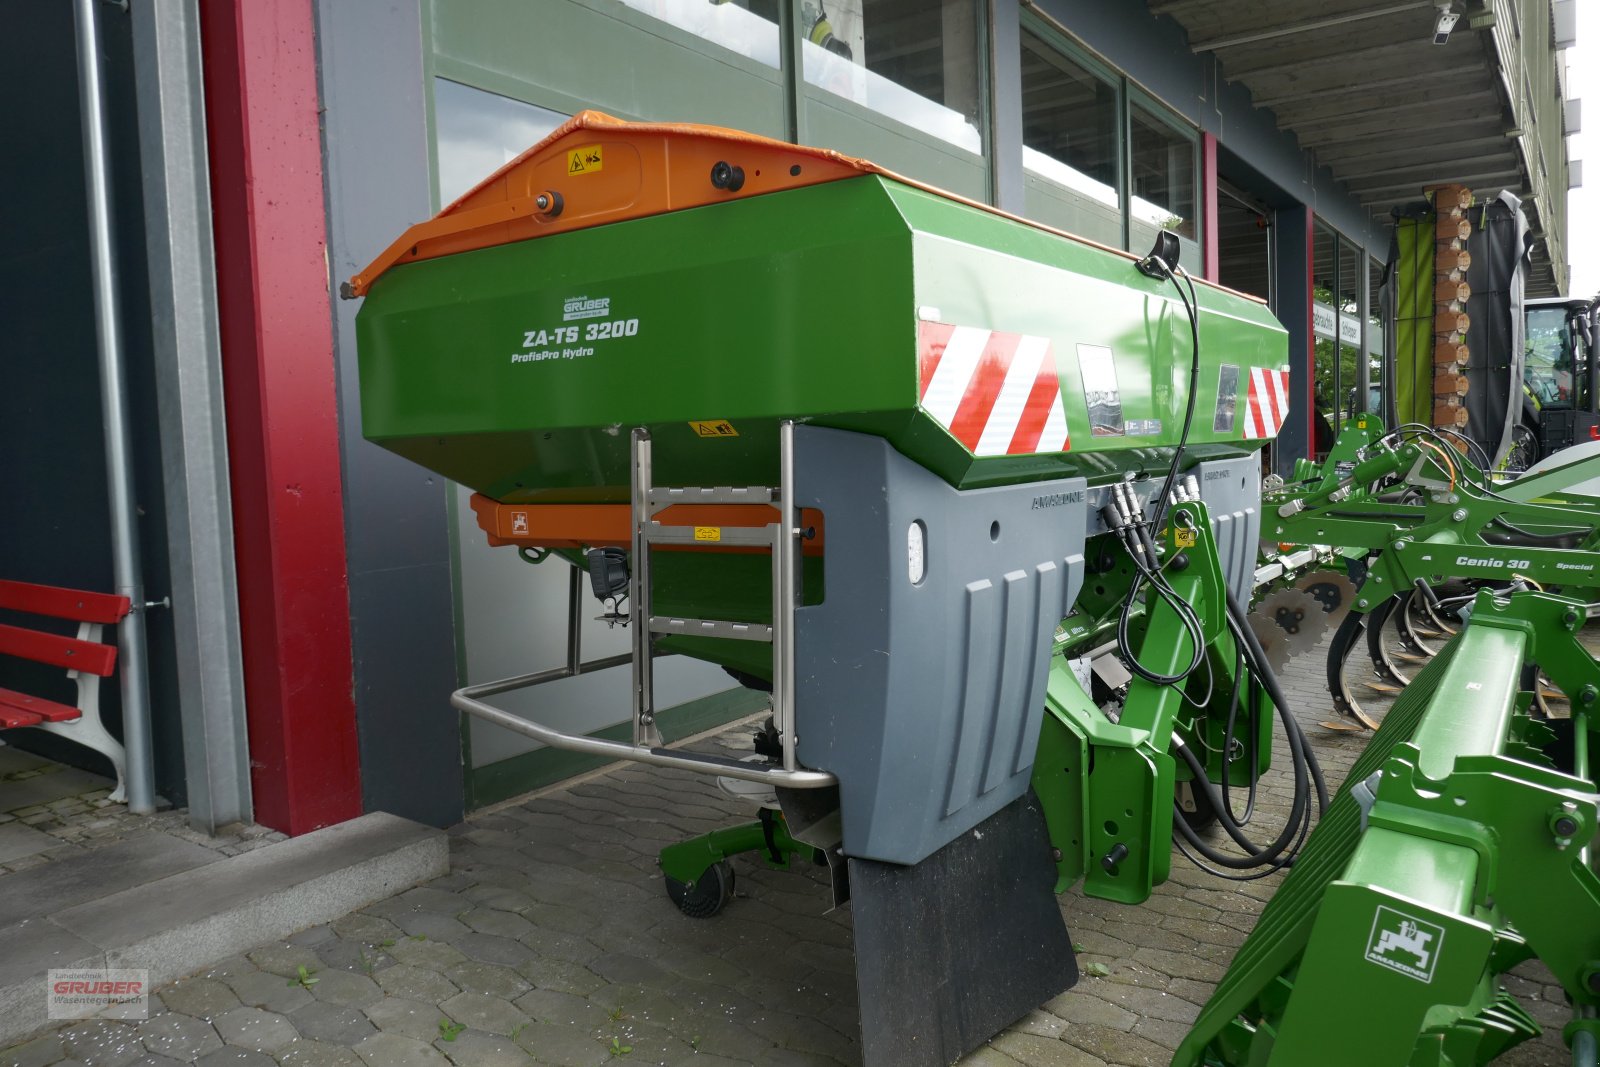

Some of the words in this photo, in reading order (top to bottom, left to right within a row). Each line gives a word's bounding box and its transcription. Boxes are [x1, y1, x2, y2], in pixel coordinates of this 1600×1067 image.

[563, 298, 610, 312] GRUBER
[522, 325, 579, 347] ZA-TS
[585, 318, 639, 340] 3200
[511, 350, 559, 363] ProfisPro
[562, 347, 594, 359] Hydro
[1032, 490, 1085, 510] AMAZONE
[1456, 556, 1504, 568] Cenio
[1507, 559, 1530, 569] 30
[1556, 562, 1594, 571] Special
[1367, 952, 1429, 979] AMAZONE
